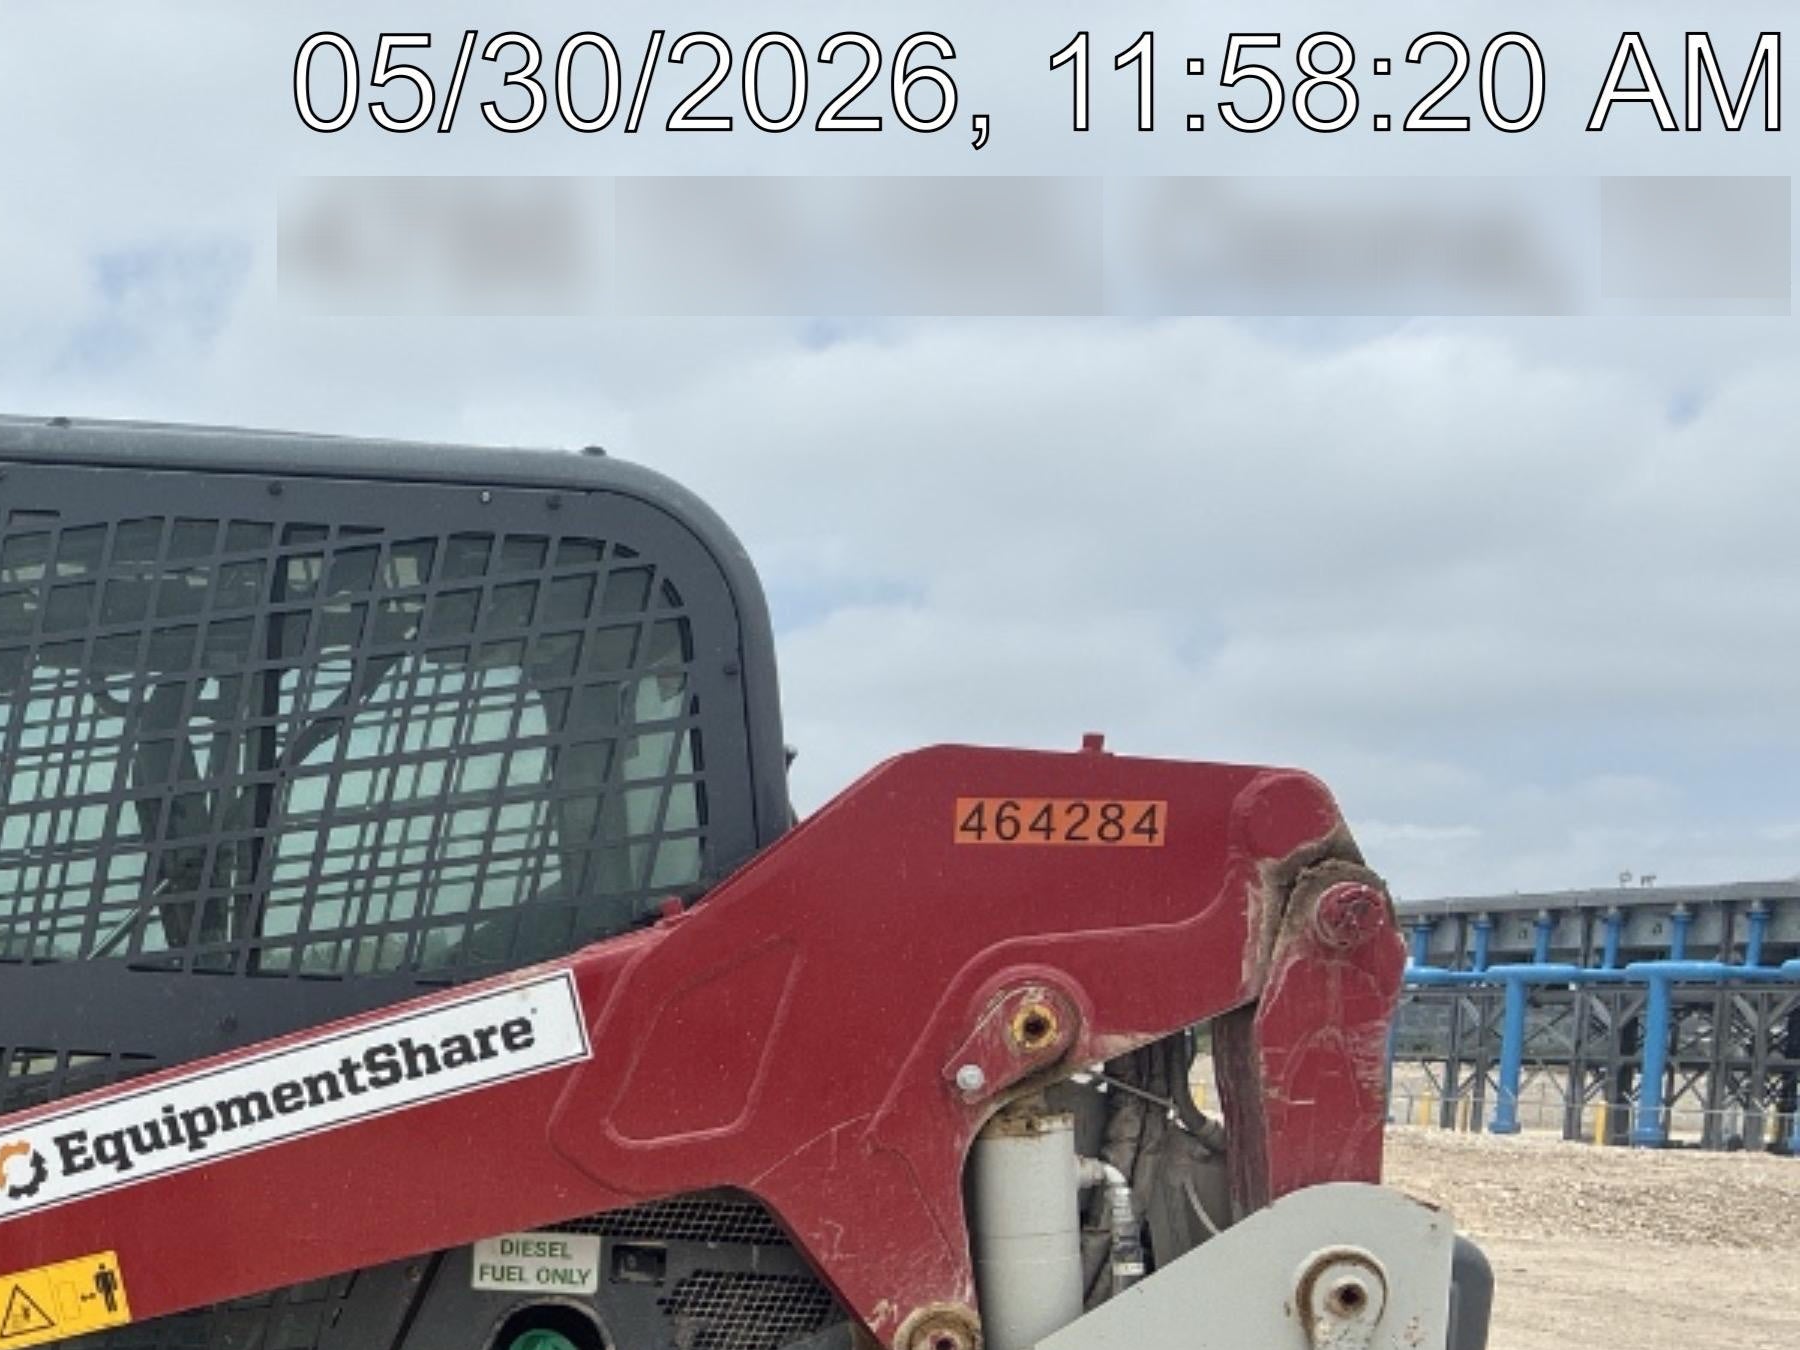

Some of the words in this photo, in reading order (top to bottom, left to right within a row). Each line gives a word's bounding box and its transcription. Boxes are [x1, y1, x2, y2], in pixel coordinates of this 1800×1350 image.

[959, 800, 1161, 843] 464284
[52, 1016, 536, 1178] EquipmentShare
[500, 1238, 572, 1260] DIESEL
[479, 1264, 529, 1284] FUEL
[536, 1266, 591, 1286] ONLY
